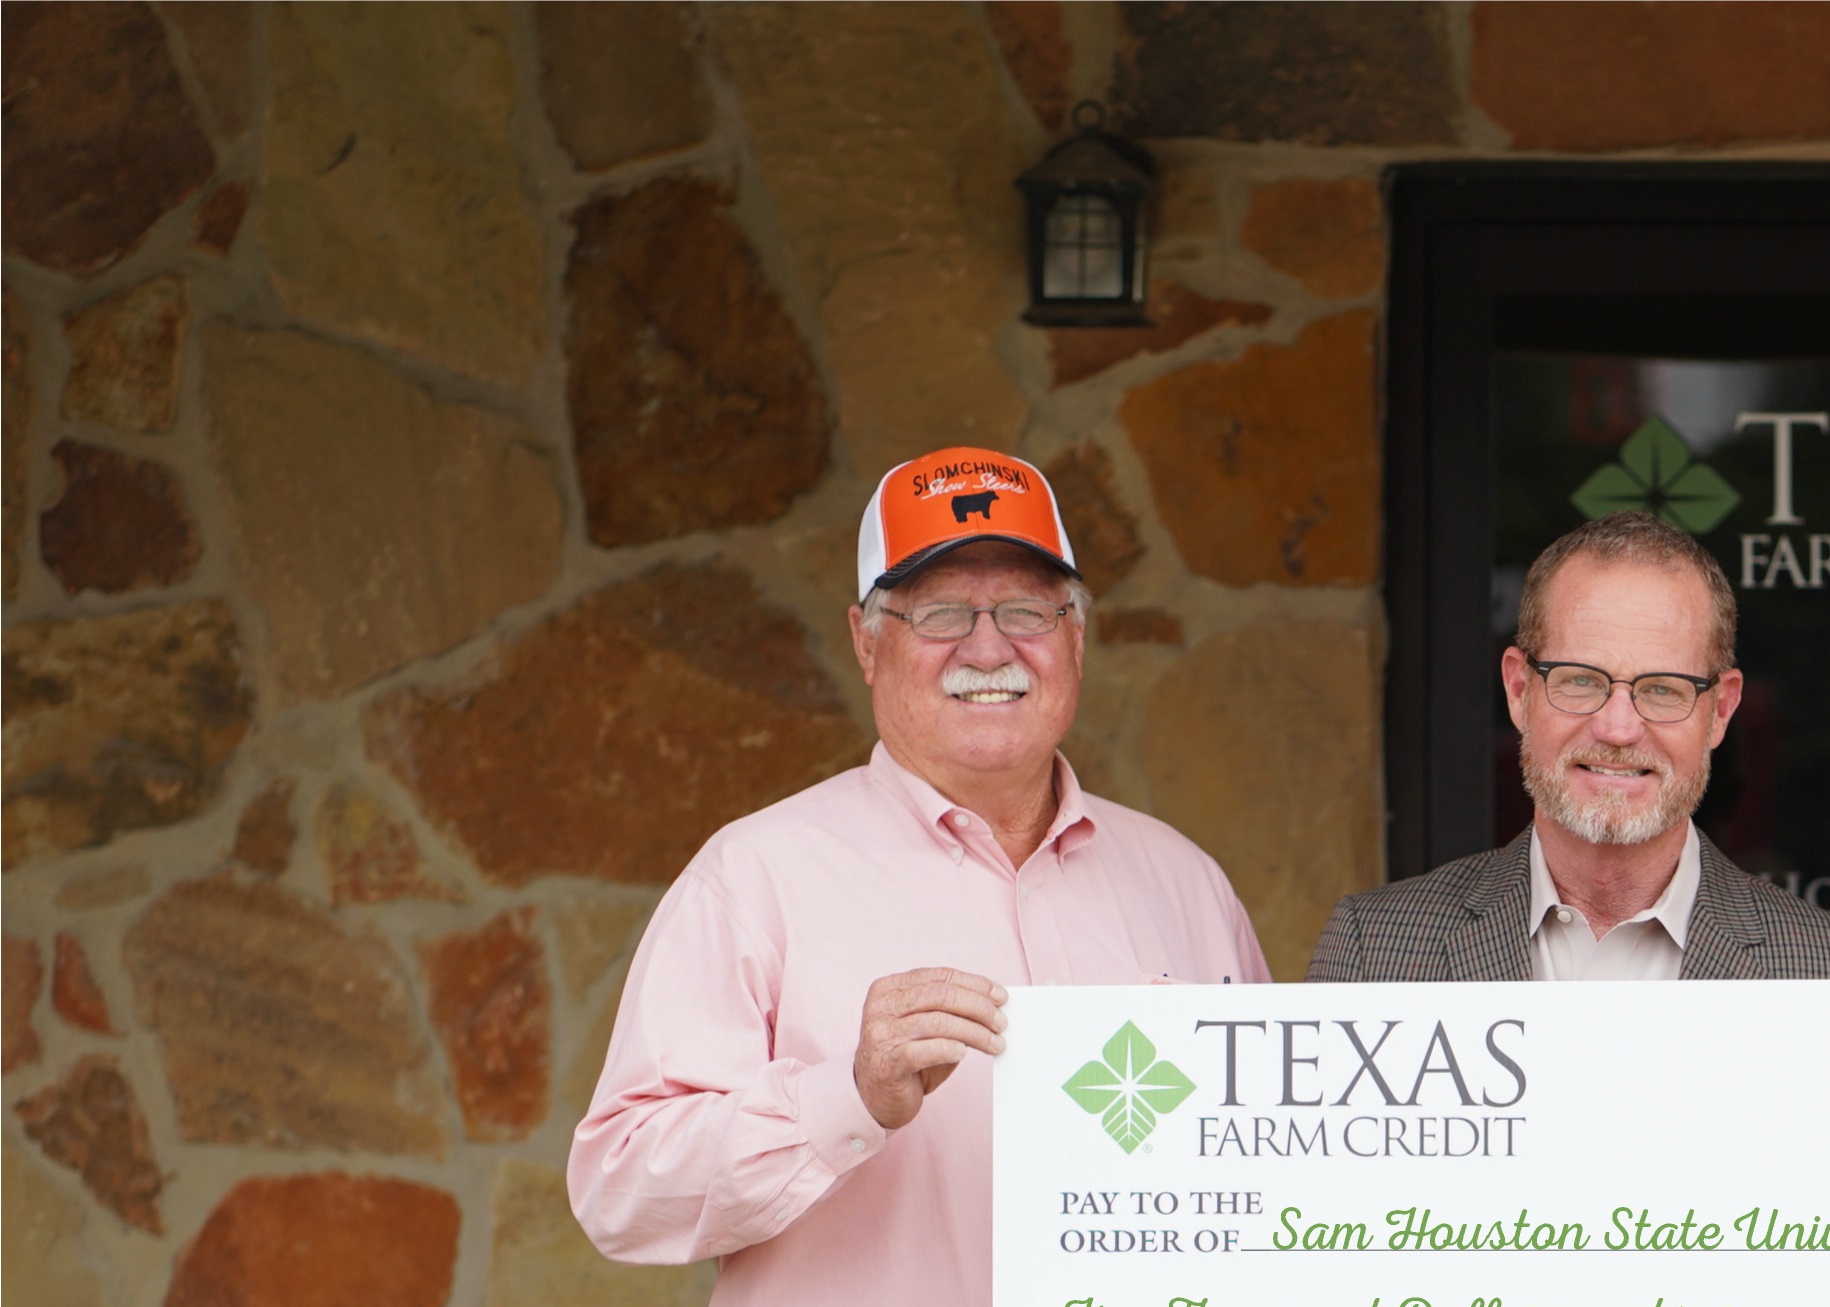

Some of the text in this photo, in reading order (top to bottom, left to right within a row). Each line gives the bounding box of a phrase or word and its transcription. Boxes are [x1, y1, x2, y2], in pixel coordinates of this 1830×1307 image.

[913, 461, 1031, 497] SLOMCHINSKI
[920, 472, 1026, 500] Show Steers
[1194, 1018, 1528, 1108] TEXAS
[1196, 1116, 1528, 1158] FARM CREDIT
[1060, 1191, 1264, 1215] PAY TO THE
[1060, 1229, 1185, 1253] ORDER
[1193, 1229, 1240, 1254] OF
[1272, 1206, 1374, 1251] Sam
[1385, 1205, 1592, 1251] Houston
[1604, 1206, 1725, 1251] State
